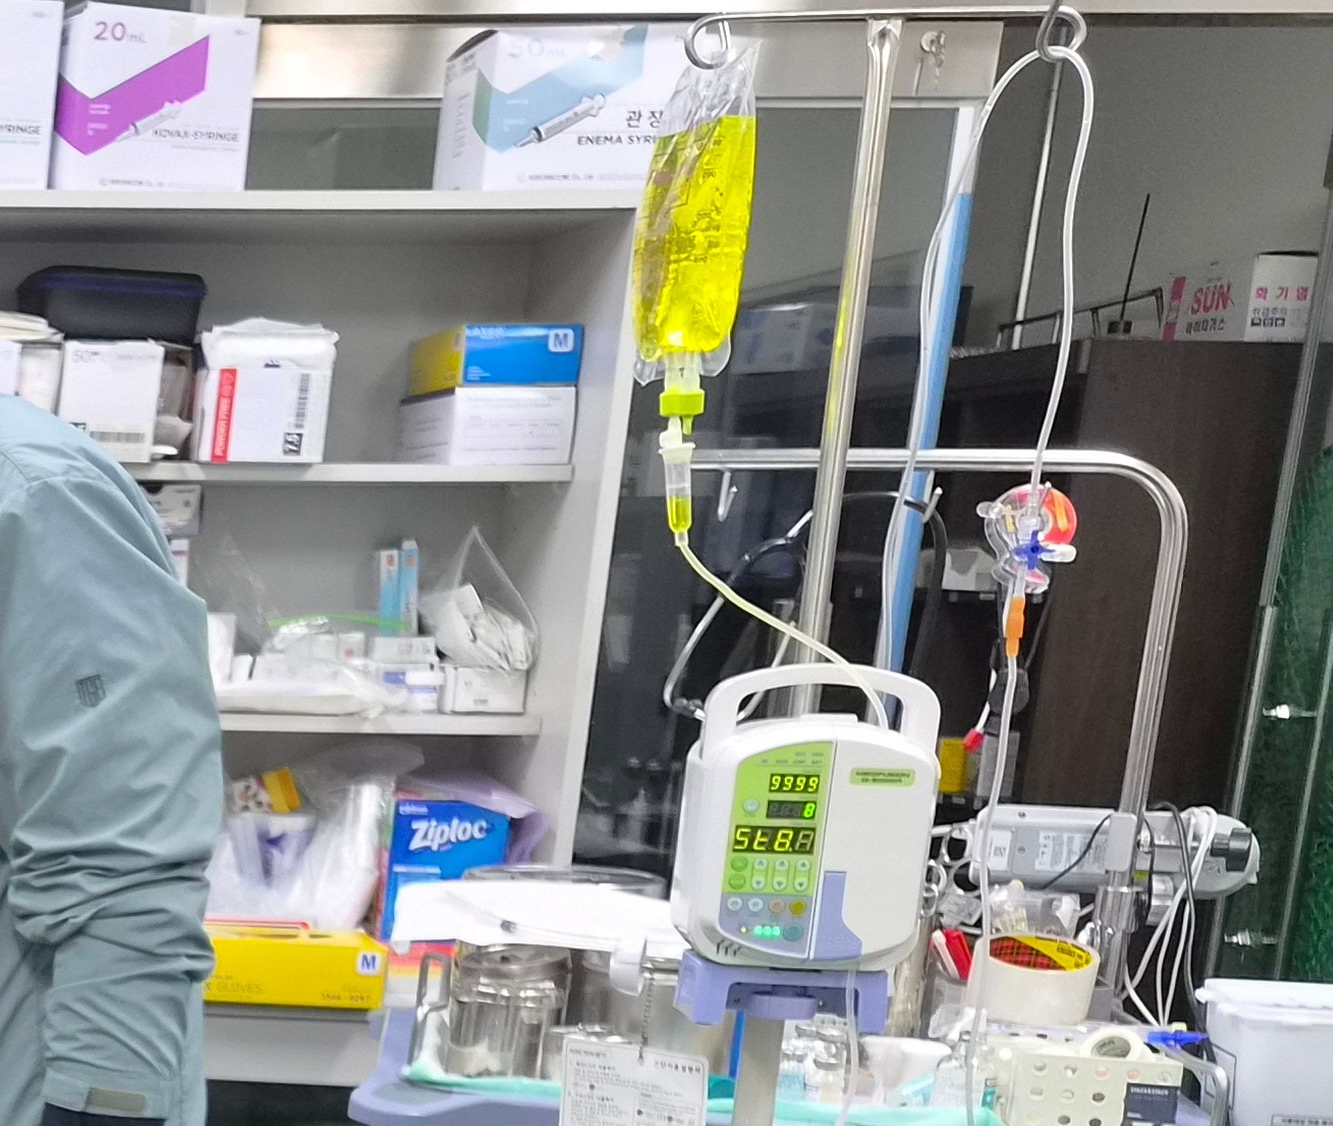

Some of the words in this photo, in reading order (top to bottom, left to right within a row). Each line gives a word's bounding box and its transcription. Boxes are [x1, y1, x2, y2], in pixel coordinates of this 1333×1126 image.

[626, 109, 644, 128] 관
[577, 135, 623, 147] ENEMA
[626, 134, 658, 146] SYRI
[1190, 281, 1233, 316] SUN
[552, 331, 571, 348] M
[769, 774, 818, 793] 9999
[408, 817, 489, 852] Ziploc
[360, 953, 377, 971] M
